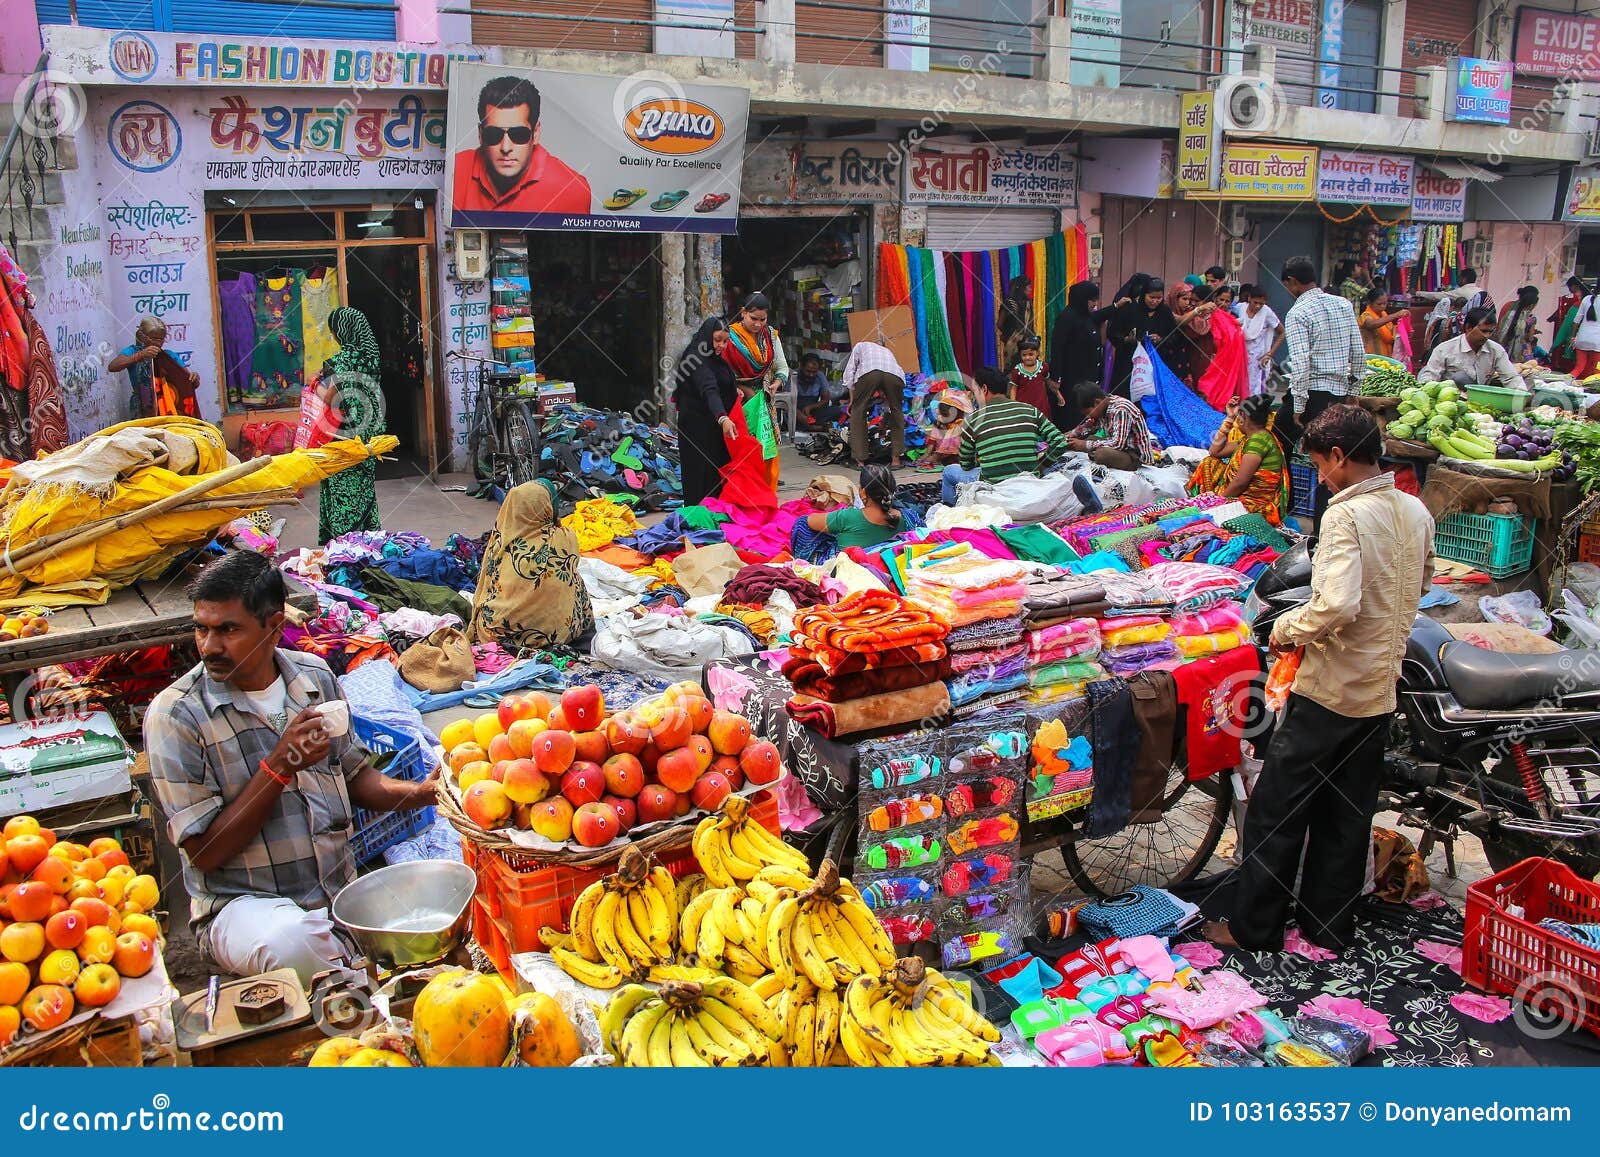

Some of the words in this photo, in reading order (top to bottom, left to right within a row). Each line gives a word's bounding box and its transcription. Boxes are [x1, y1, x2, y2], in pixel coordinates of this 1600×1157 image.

[1251, 0, 1312, 25] EXIDE
[1251, 23, 1309, 44] BATTERIES
[1534, 18, 1596, 51] EXIDE
[114, 41, 152, 72] NEW
[175, 42, 328, 82] FASHION
[333, 48, 480, 87] BOUTIQ
[1532, 49, 1583, 65] BATTERIES
[1471, 64, 1500, 88] दीपक
[1457, 95, 1477, 110] पान
[208, 95, 346, 154] फैशन
[634, 108, 716, 142] RELAXO
[120, 112, 172, 164] न्यू
[1185, 134, 1207, 150] बाबा
[619, 156, 653, 170] Quality
[655, 157, 671, 168] Par
[672, 158, 722, 170] Excellence
[911, 147, 990, 193] स्वाती
[1228, 159, 1261, 176] बाबा
[1321, 154, 1374, 175] गोपाल
[1379, 158, 1411, 182] सिंह
[1320, 178, 1345, 191] मान
[1346, 177, 1372, 193] देवी
[1415, 168, 1465, 196] दीपक
[1414, 197, 1430, 211] पान
[1431, 198, 1463, 214] भण्डार
[562, 218, 591, 228] AYUSH
[593, 218, 641, 229] FOOTWEAR
[124, 262, 186, 285] ब्लाउज
[130, 291, 191, 316] लहंगा
[55, 324, 93, 354] Blouse
